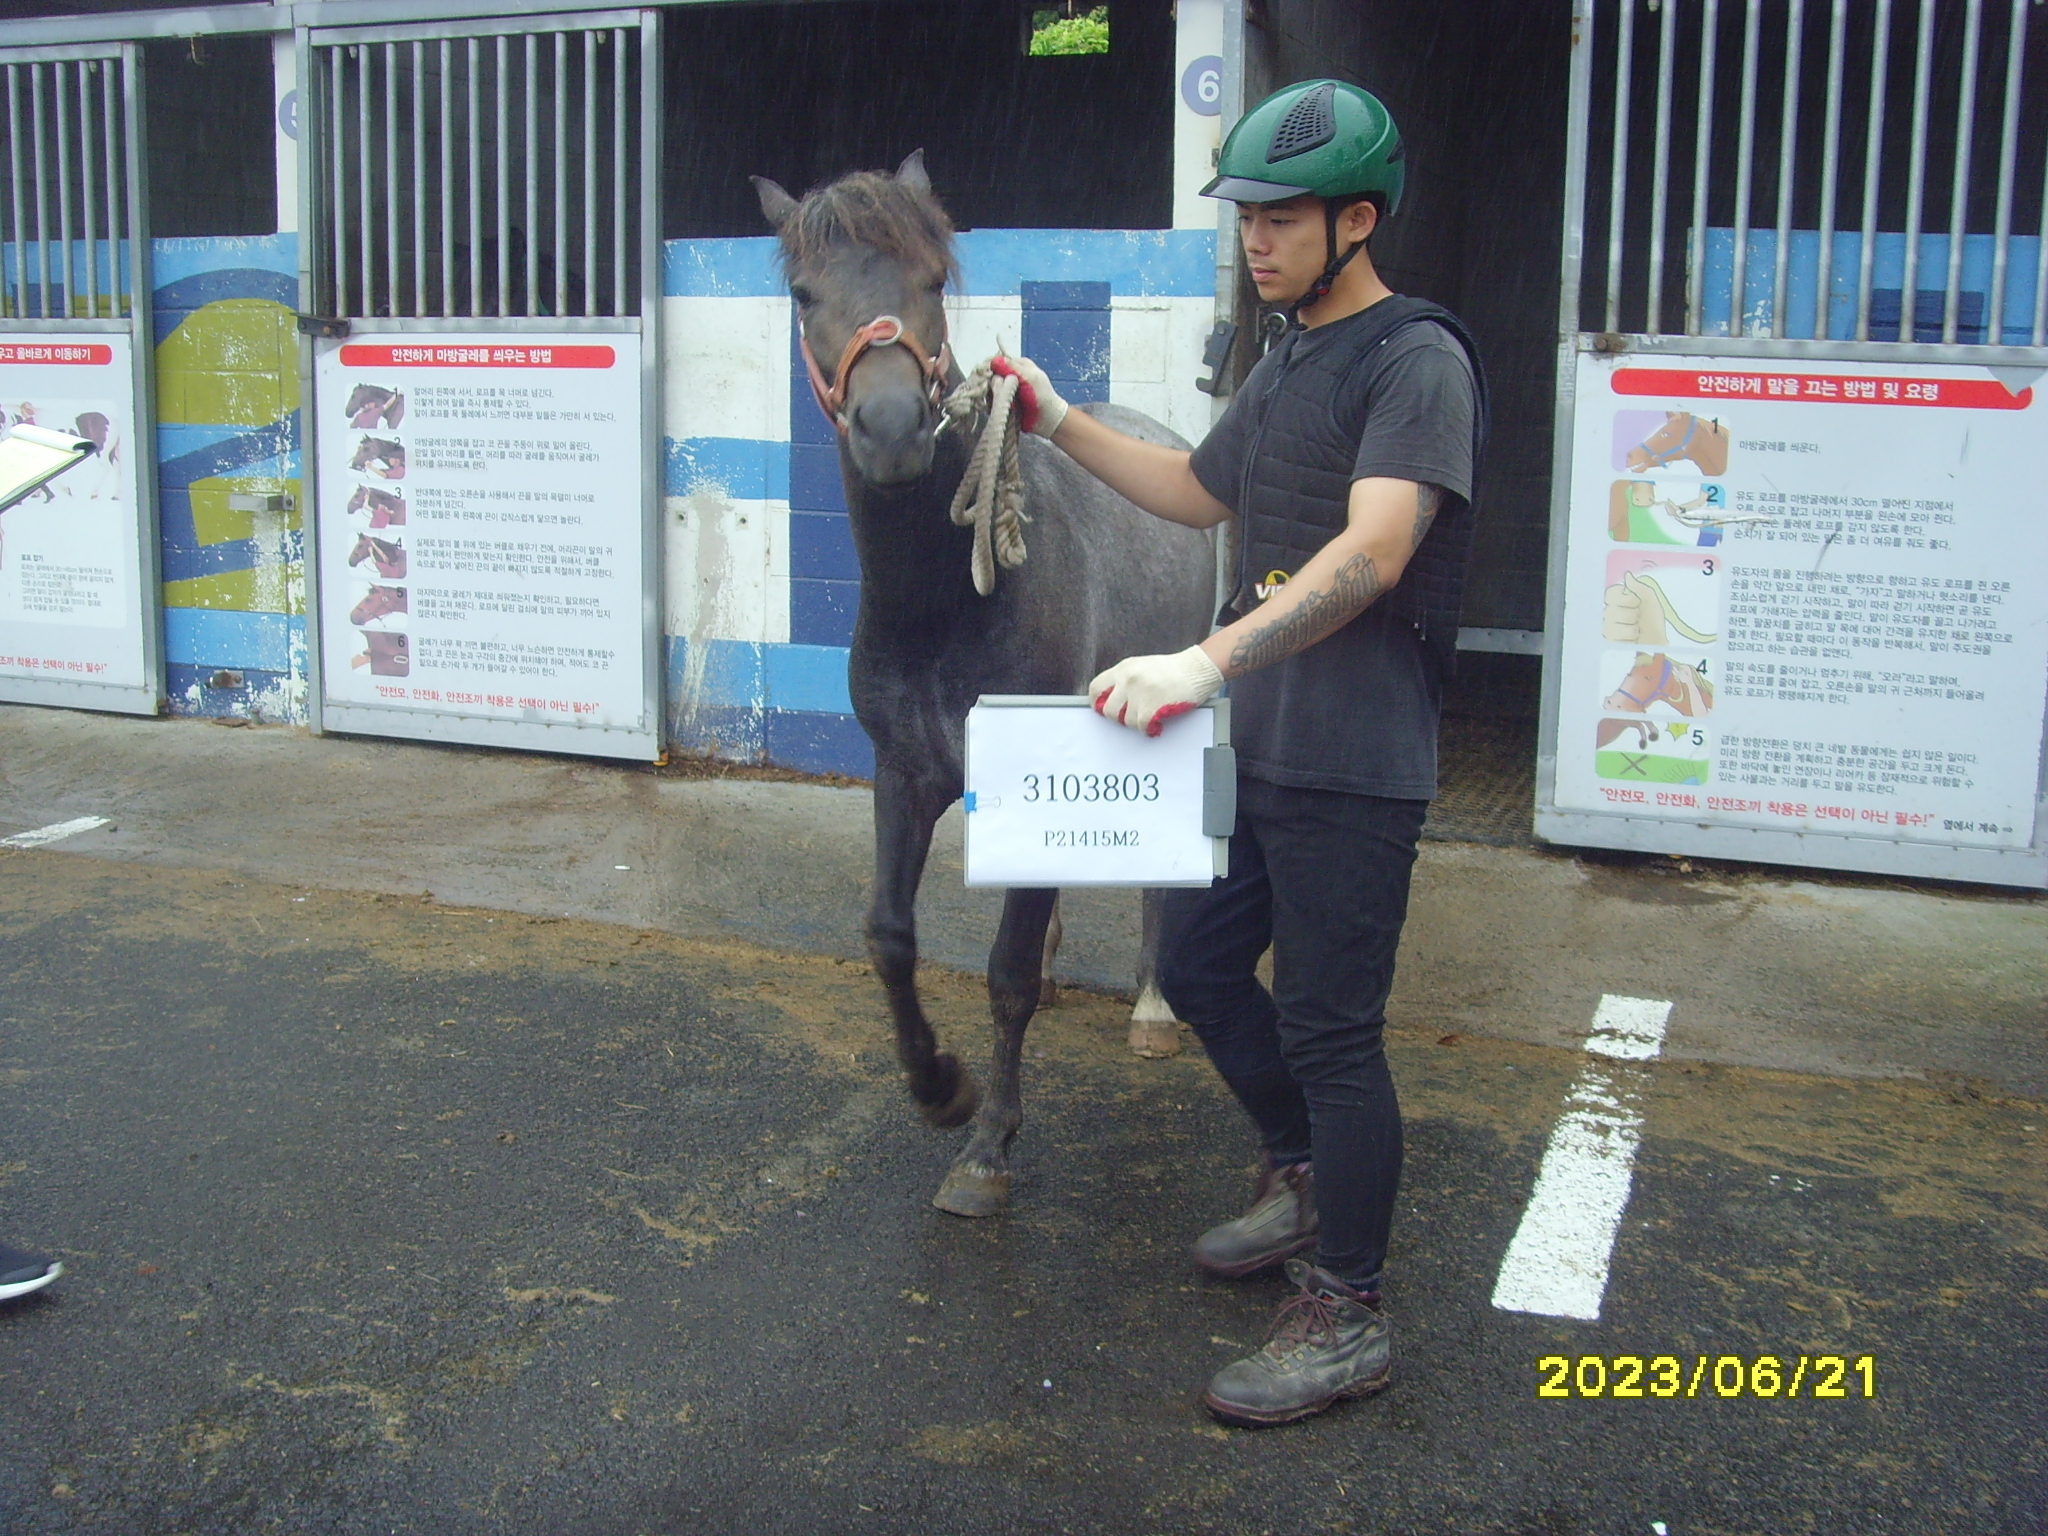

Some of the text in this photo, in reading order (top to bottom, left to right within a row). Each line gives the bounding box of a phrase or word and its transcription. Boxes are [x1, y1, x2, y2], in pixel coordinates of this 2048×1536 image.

[1198, 70, 1220, 103] 6
[16, 347, 52, 360] 올바르게
[54, 347, 91, 361] 이동하기
[392, 348, 552, 364] 안전하게 마방굴레를 씌우는 방법
[393, 387, 399, 400] 1
[414, 387, 554, 398] 말머리 왼쪽에 서서, 로프를 목 너머로 넘긴다.
[1697, 375, 1938, 401] 안전하게 말을 끄는 방법 및 요령
[1711, 417, 1719, 434] 1
[1739, 440, 1821, 454] 마방굴레를 씌운다.
[395, 487, 402, 500] 3
[1707, 486, 1719, 502] 2
[1736, 491, 1954, 511] 유도 로프를 마방굴레에서 30cm 떨어진 지점에서
[1758, 505, 1786, 517] 손으로
[1790, 506, 1808, 517] 잡고
[1812, 508, 1841, 519] 나머지
[1844, 509, 1873, 520] 부분을
[1878, 510, 1907, 522] 왼손에
[1910, 513, 1930, 523] 모아
[1934, 513, 1955, 525] 쥔다.
[395, 537, 402, 549] 4
[1702, 559, 1714, 576] 3
[1730, 592, 1992, 616] 조심스럽게 걷기 시작하고, 말이 따라 걷기 시작하면 곧 유도
[397, 636, 405, 648] 6
[1727, 641, 1853, 659] 잡으려고 하는 습관을 없앤다.
[17, 656, 39, 668] 착용은
[43, 658, 65, 670] 선택이
[68, 661, 83, 672] 아닌
[419, 658, 557, 677] 밑으로 손가락 두 개가 들어갈 수 있어야 한다.
[1696, 659, 1708, 675] 4
[1724, 686, 1850, 704] 유도 로프가 팽팽해지게 한다.
[1725, 673, 1985, 701] 유도 로프를 줄여 잡고, 오른손을 말의 귀 근처까지 들어올려
[412, 689, 442, 702] 안전화,
[446, 691, 483, 705] 안전조끼
[487, 695, 514, 707] 착용은
[518, 698, 546, 711] 선택이
[550, 700, 568, 712] 아닌
[1692, 730, 1703, 746] 5
[1721, 735, 1978, 764] 급한 방향전환은 덩치 큰 네발 동물에게는 쉽지 않은 일이다.
[1720, 748, 1968, 776] 미리 방향 전환을 계획하고 충분한 공간을 두고 크게 돈다.
[1022, 773, 1160, 803] 3103803
[1718, 771, 1897, 795] 있는 사물과는 거리를 두고 말을 유도한다.
[1656, 792, 1700, 809] 안전화,
[1707, 796, 1761, 813] 안전조끼
[1767, 801, 1808, 817] 착용은
[1814, 805, 1855, 821] 선택이
[1861, 809, 1888, 824] 아닌
[1943, 819, 1998, 835] 옆에서 계속
[1044, 829, 1140, 848] P21415M2
